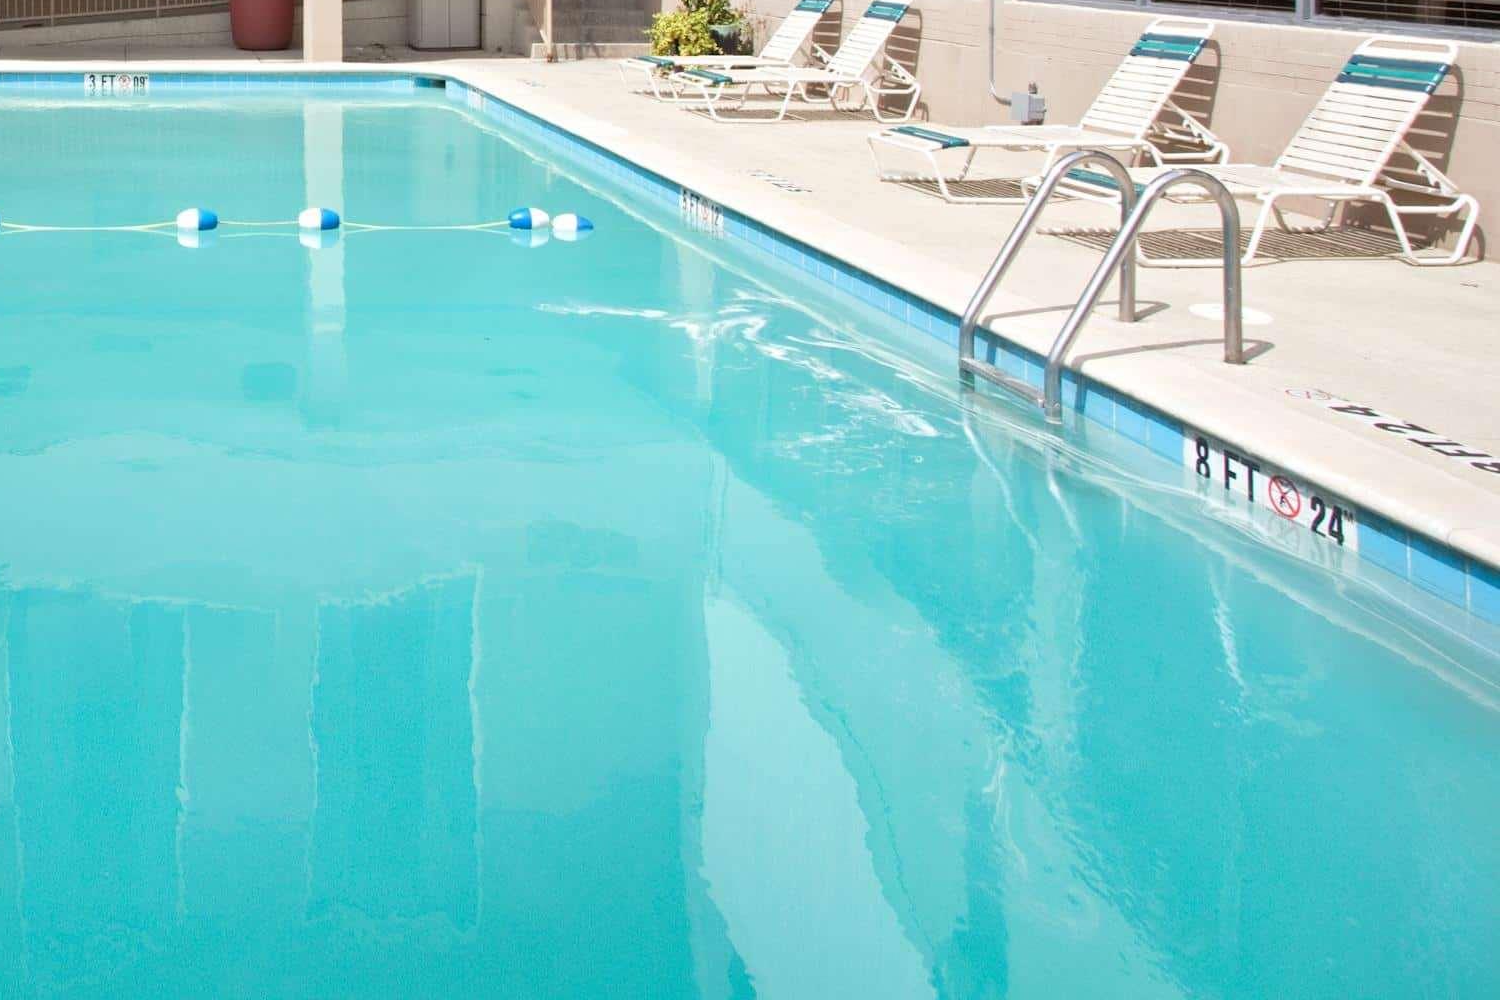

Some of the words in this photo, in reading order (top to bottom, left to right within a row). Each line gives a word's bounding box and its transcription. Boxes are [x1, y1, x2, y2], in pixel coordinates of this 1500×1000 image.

[89, 74, 96, 88] 3
[101, 74, 117, 87] FT
[1195, 437, 1211, 479] 8
[1223, 449, 1261, 503] FT
